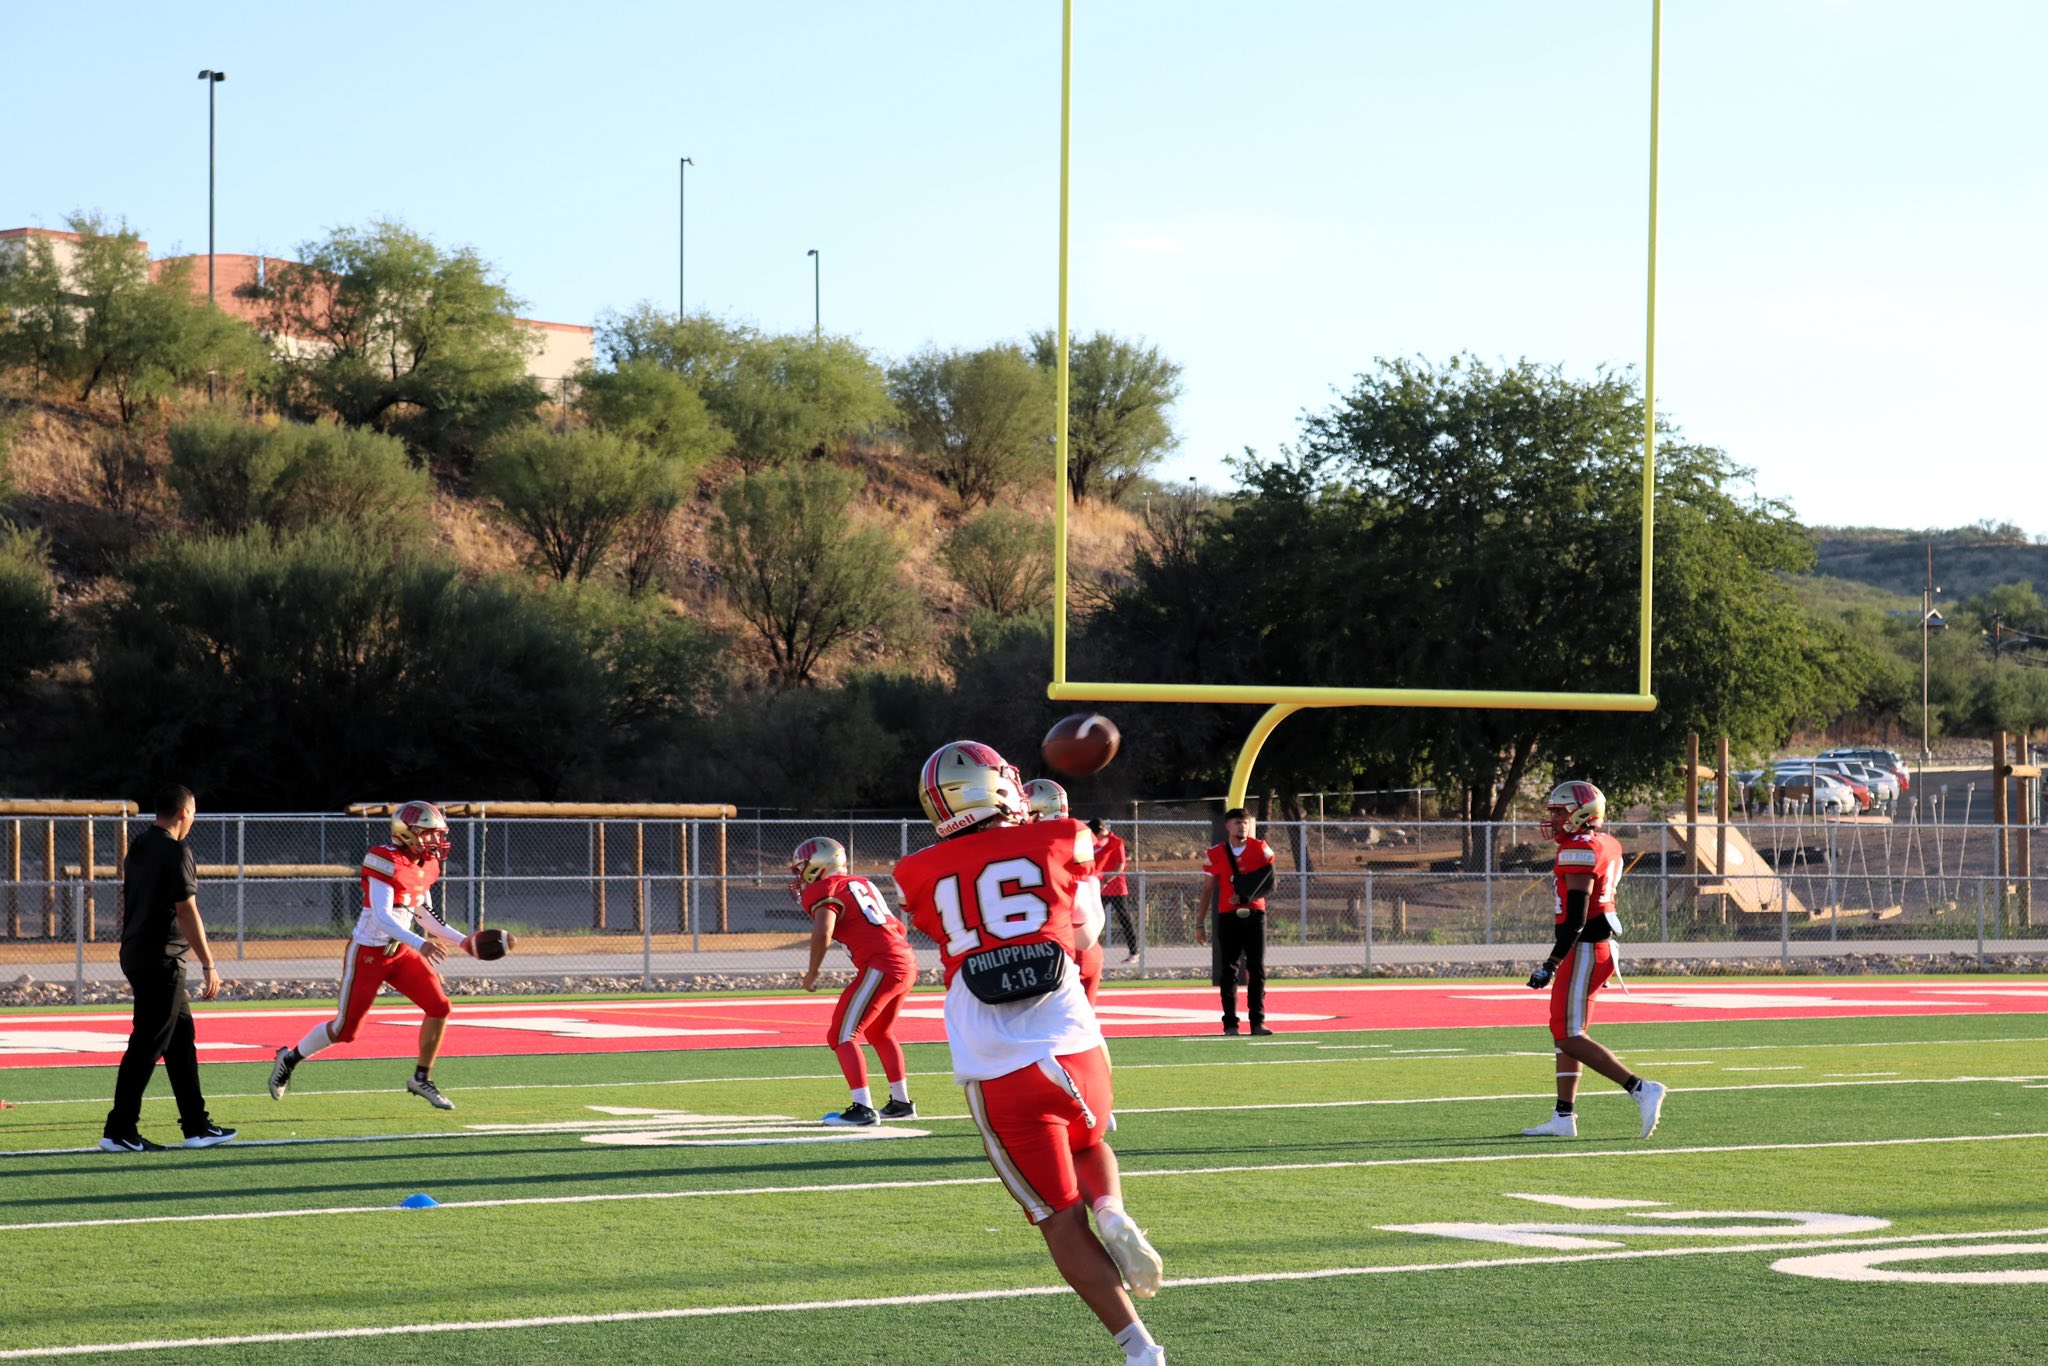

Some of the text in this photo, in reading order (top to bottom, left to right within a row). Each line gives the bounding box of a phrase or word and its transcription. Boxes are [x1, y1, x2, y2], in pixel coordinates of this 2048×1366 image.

[938, 814, 976, 836] Riddell
[934, 857, 1048, 957] 16
[968, 942, 1055, 975] PHILIPPIANS
[1001, 966, 1038, 991] 4:13
